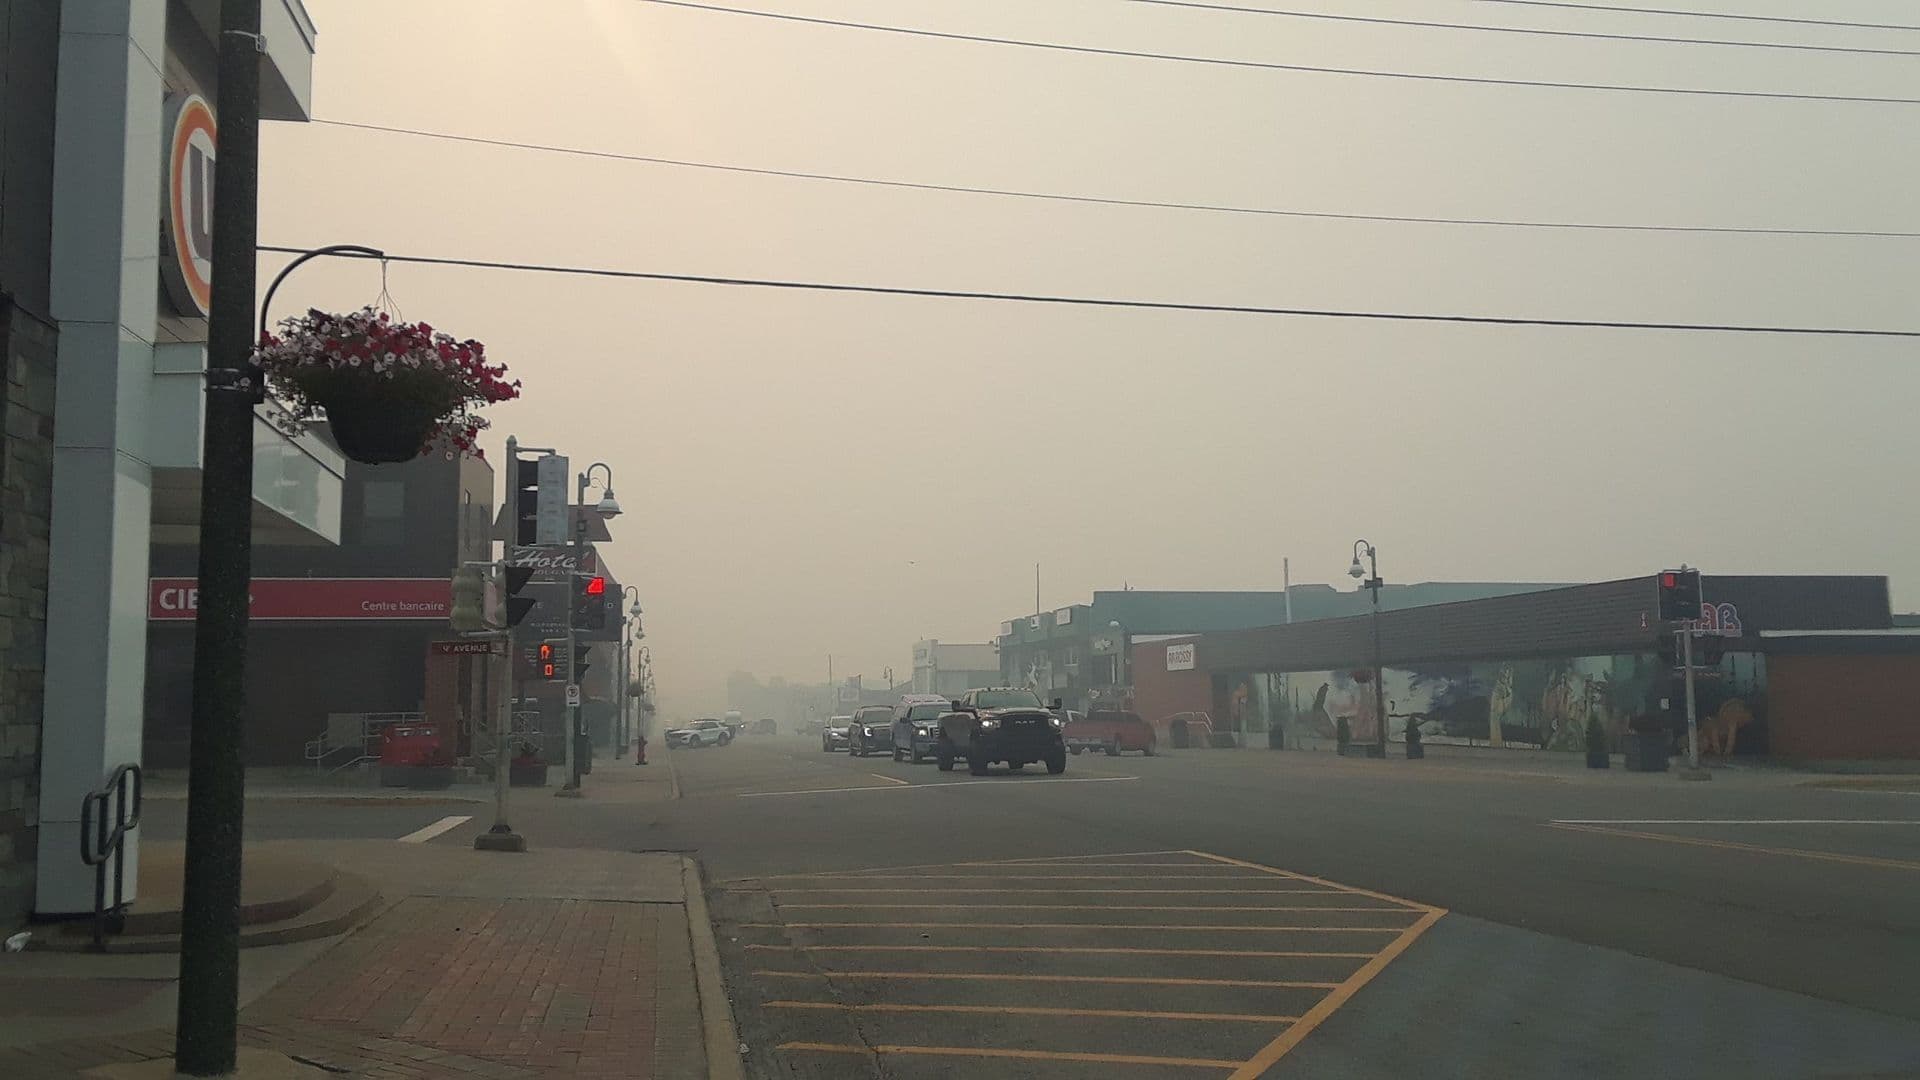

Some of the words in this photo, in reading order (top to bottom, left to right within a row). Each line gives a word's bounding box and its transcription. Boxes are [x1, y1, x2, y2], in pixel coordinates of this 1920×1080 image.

[361, 601, 397, 611] Centre
[399, 601, 444, 611] bancaire
[454, 644, 488, 653] AVENUE
